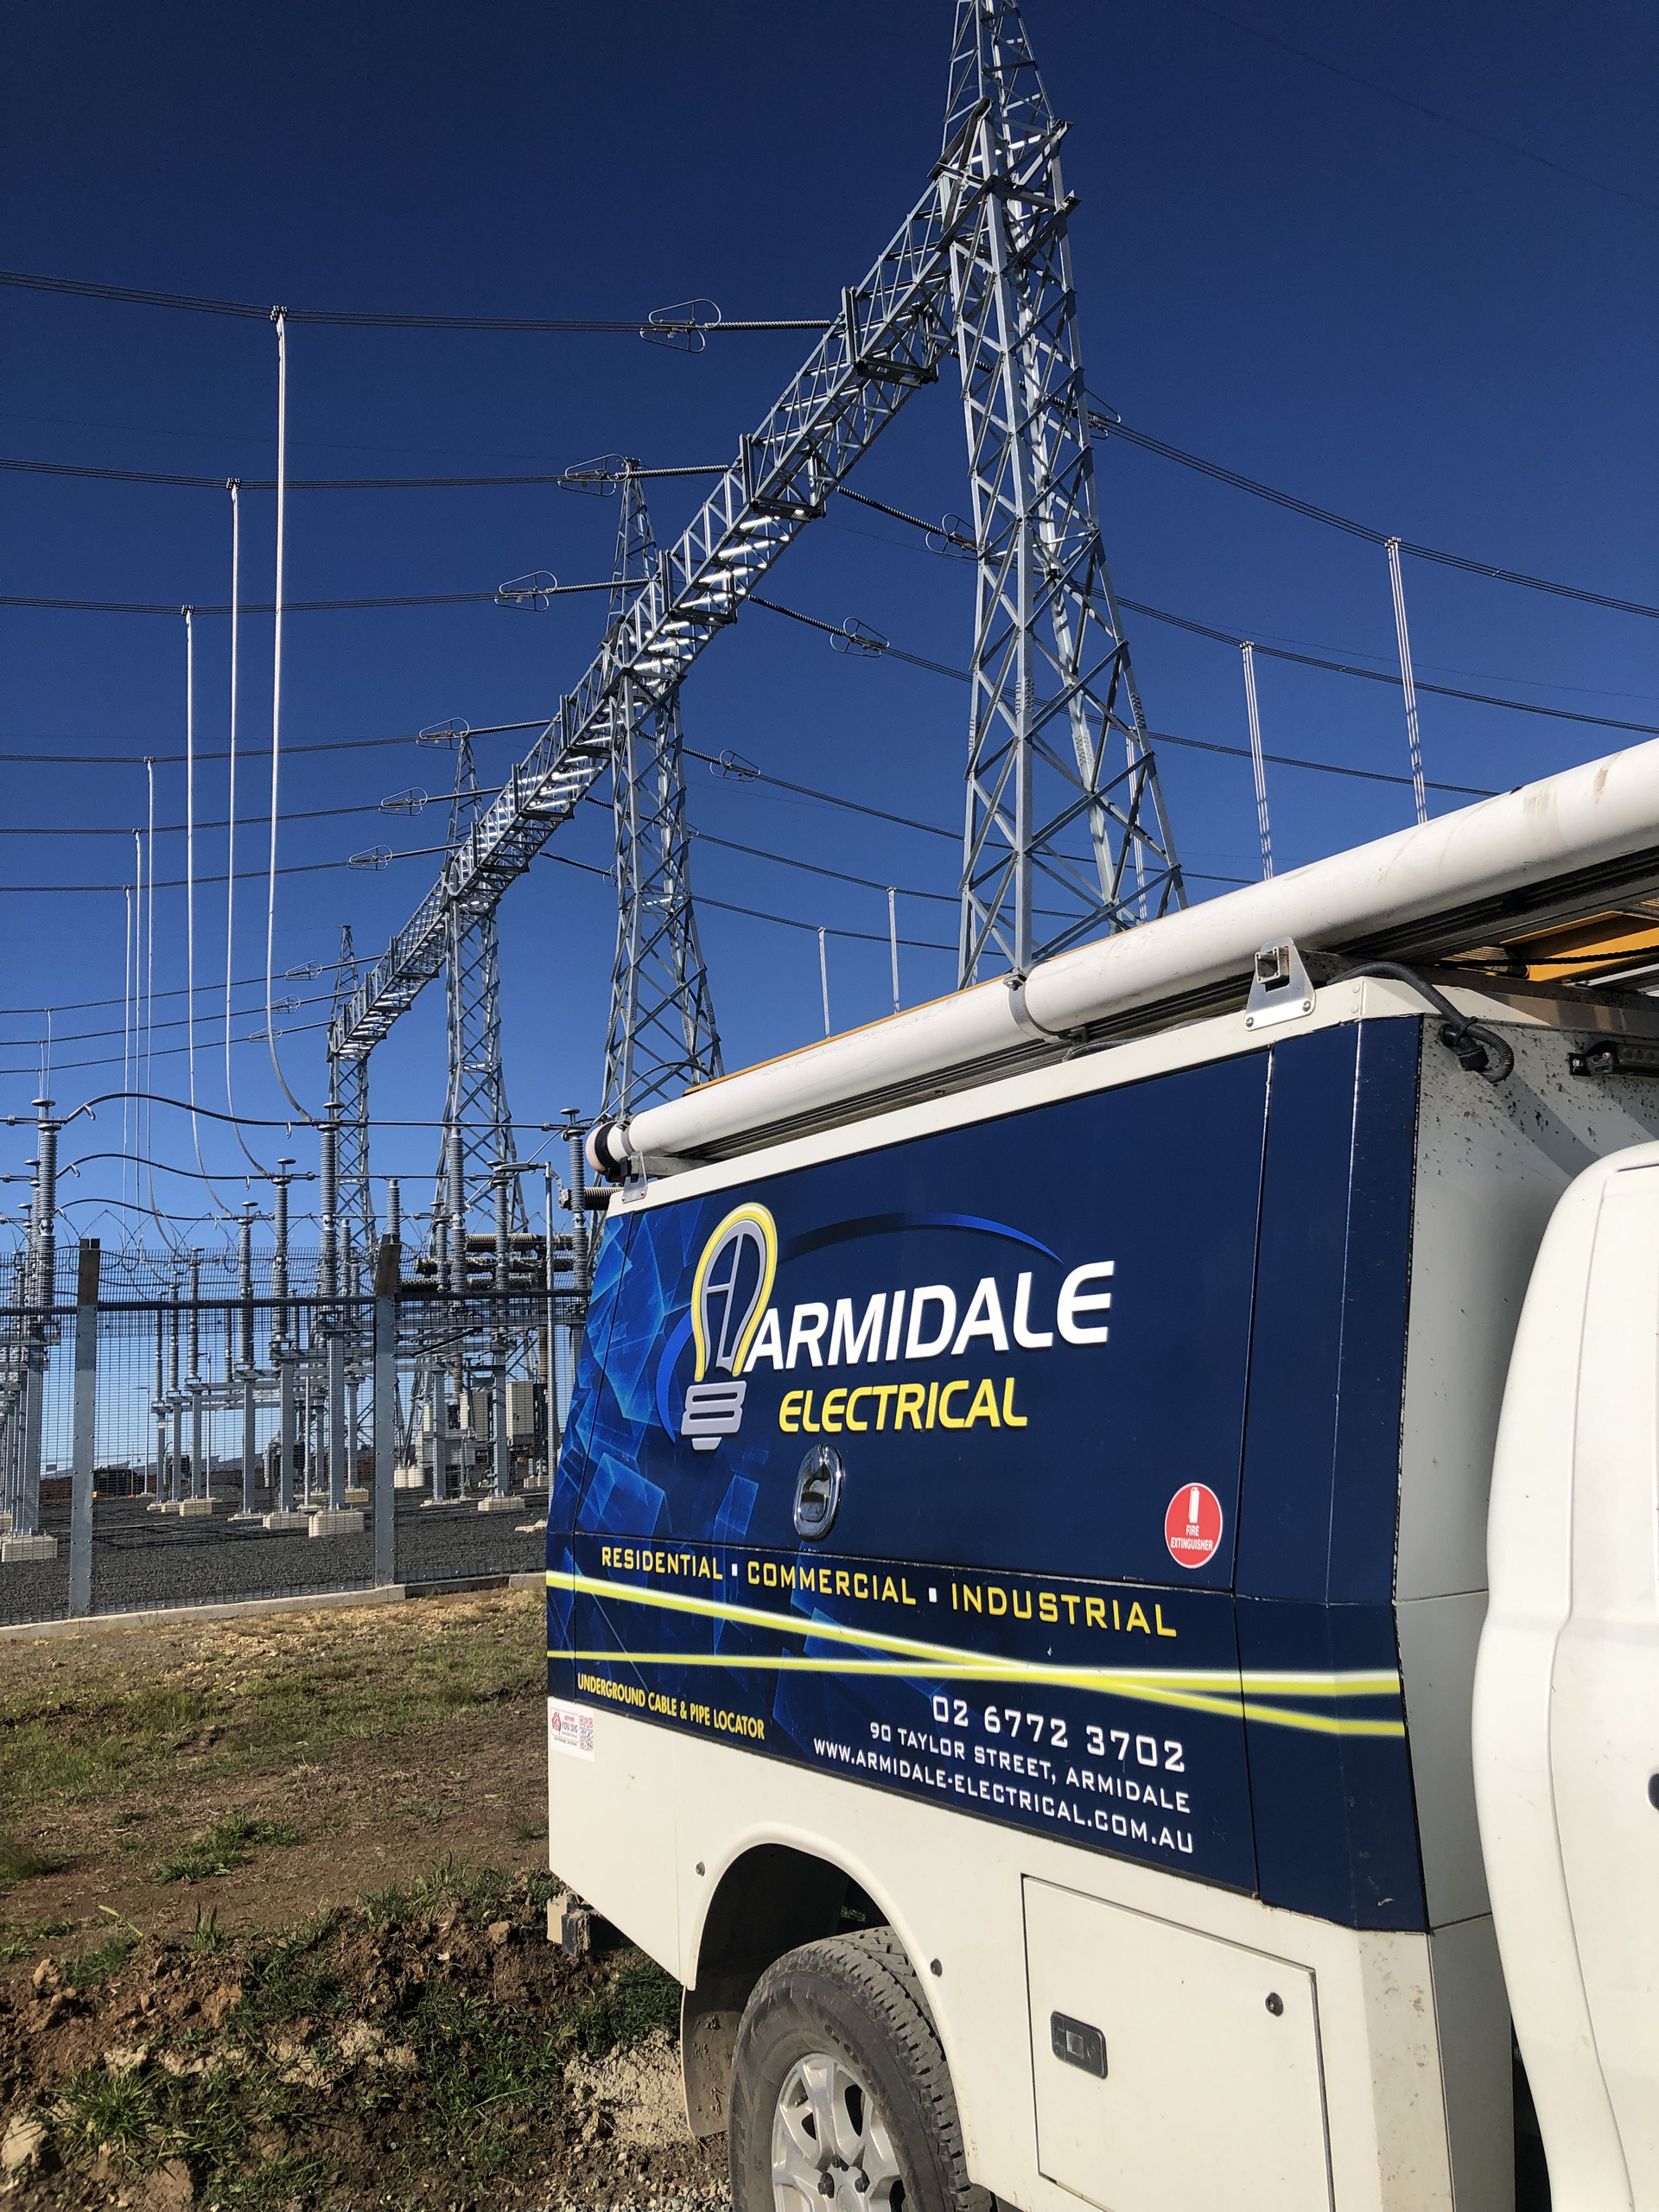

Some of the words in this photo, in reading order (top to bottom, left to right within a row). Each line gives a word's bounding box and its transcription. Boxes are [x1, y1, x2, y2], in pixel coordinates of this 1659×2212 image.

[743, 1260, 1116, 1373] ARMIDALE
[779, 1376, 1028, 1433] ELECTRICAL
[1170, 1536, 1213, 1552] EXTINGUISHER
[1185, 1524, 1199, 1536] FIRE
[601, 1546, 723, 1580] RESIDENTIAL
[747, 1560, 917, 1605] COMMERCIAL
[951, 1583, 1178, 1637] INDUSTRIAL
[562, 1720, 570, 1731] YOU
[577, 1672, 645, 1708] UNDERGROUND
[647, 1691, 677, 1717] CABLE
[679, 1704, 688, 1718] &
[690, 1702, 710, 1726] PIPE
[713, 1709, 766, 1740] LOCATOR
[932, 1696, 969, 1727] 02
[983, 1706, 1069, 1749] 6772
[1085, 1725, 1186, 1773] 3702
[813, 1737, 1194, 1854] WWW.ARMIDALE-ELECTRICAL.COM.AU
[870, 1721, 892, 1743] 90
[897, 1727, 966, 1761] TAYLOR
[974, 1746, 1058, 1786] STREET,
[1065, 1767, 1192, 1814] ARMIDALE
